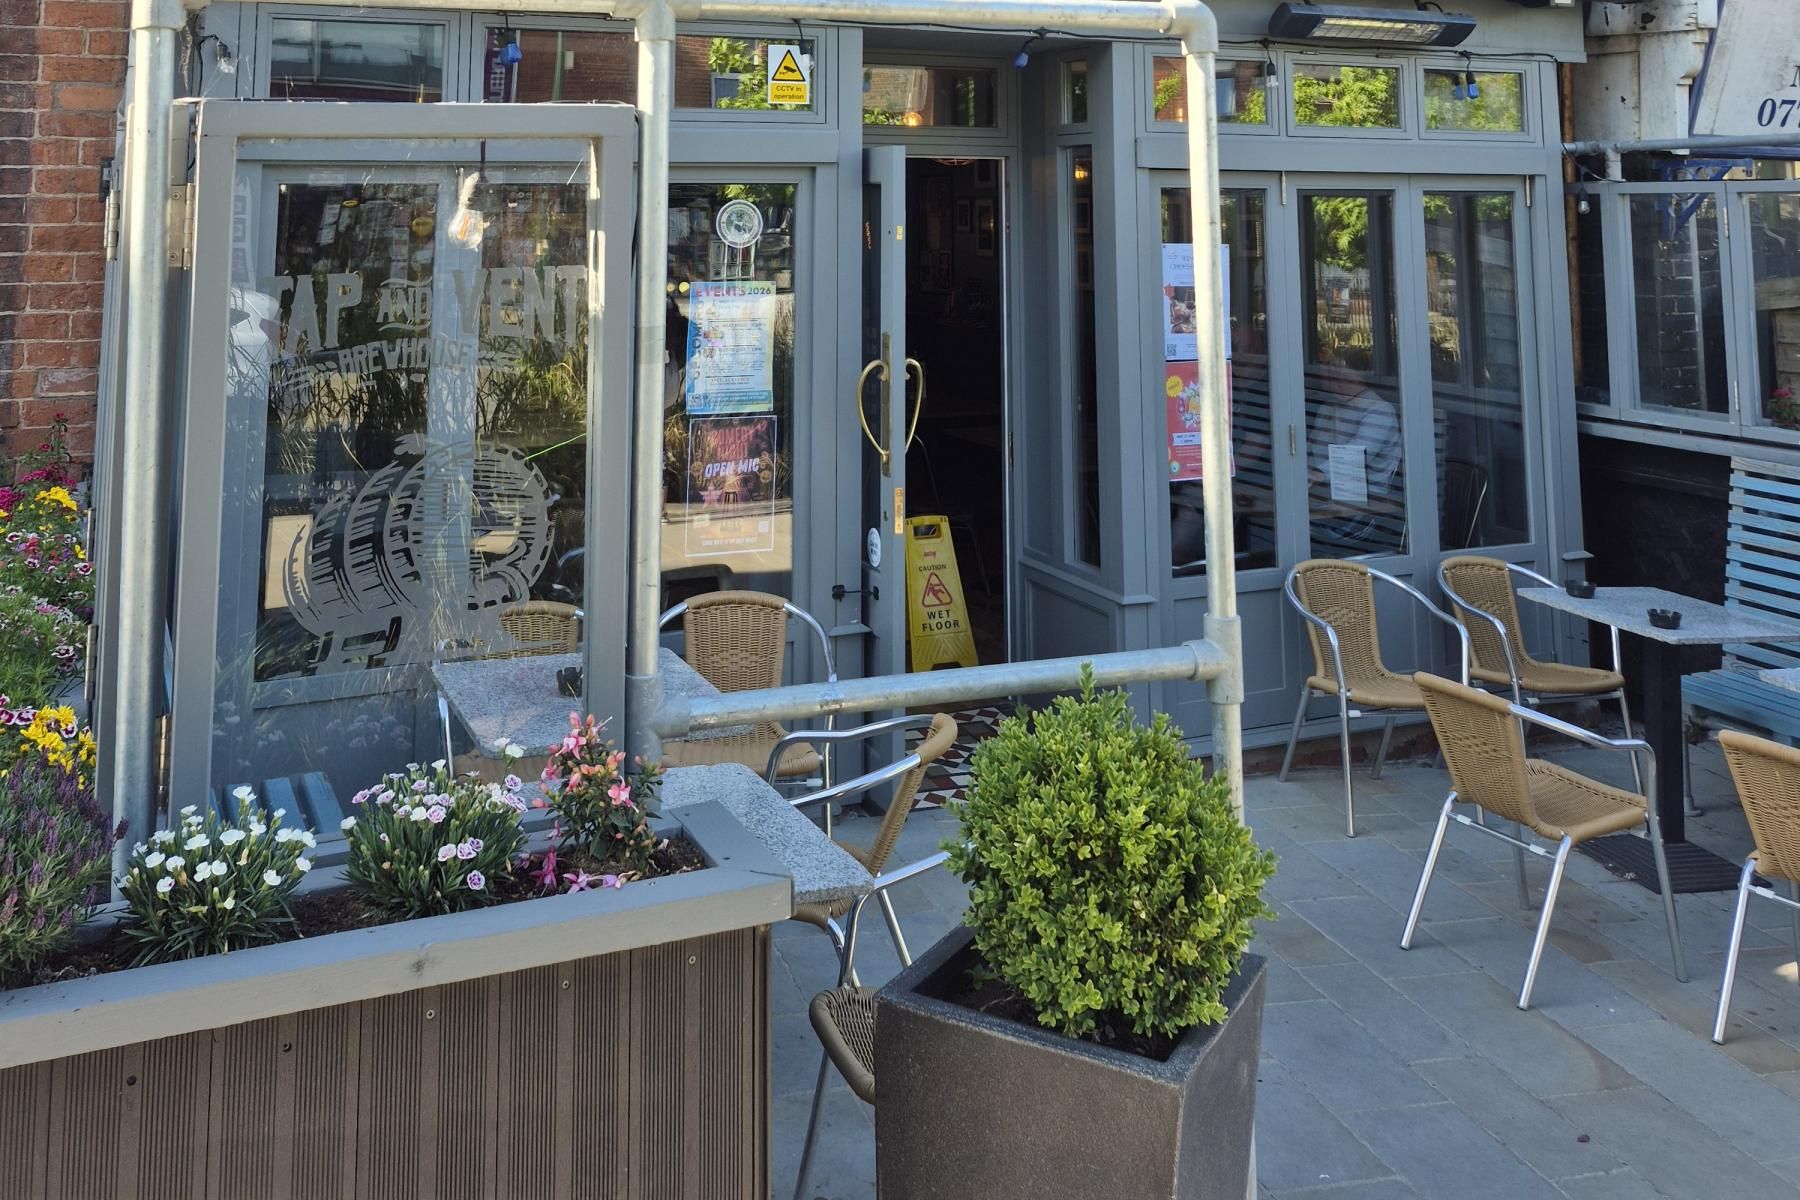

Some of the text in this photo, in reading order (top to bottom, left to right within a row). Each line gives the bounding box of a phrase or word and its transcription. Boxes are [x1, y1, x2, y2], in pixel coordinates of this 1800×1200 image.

[1757, 98, 1800, 128] 07
[695, 286, 771, 297] EVENTS 2026
[257, 264, 588, 355] TAP AND VENT
[704, 457, 760, 478] OPEN MIC
[918, 564, 947, 572] CAUTION
[927, 609, 951, 620] WET
[922, 620, 960, 632] FLOOR
